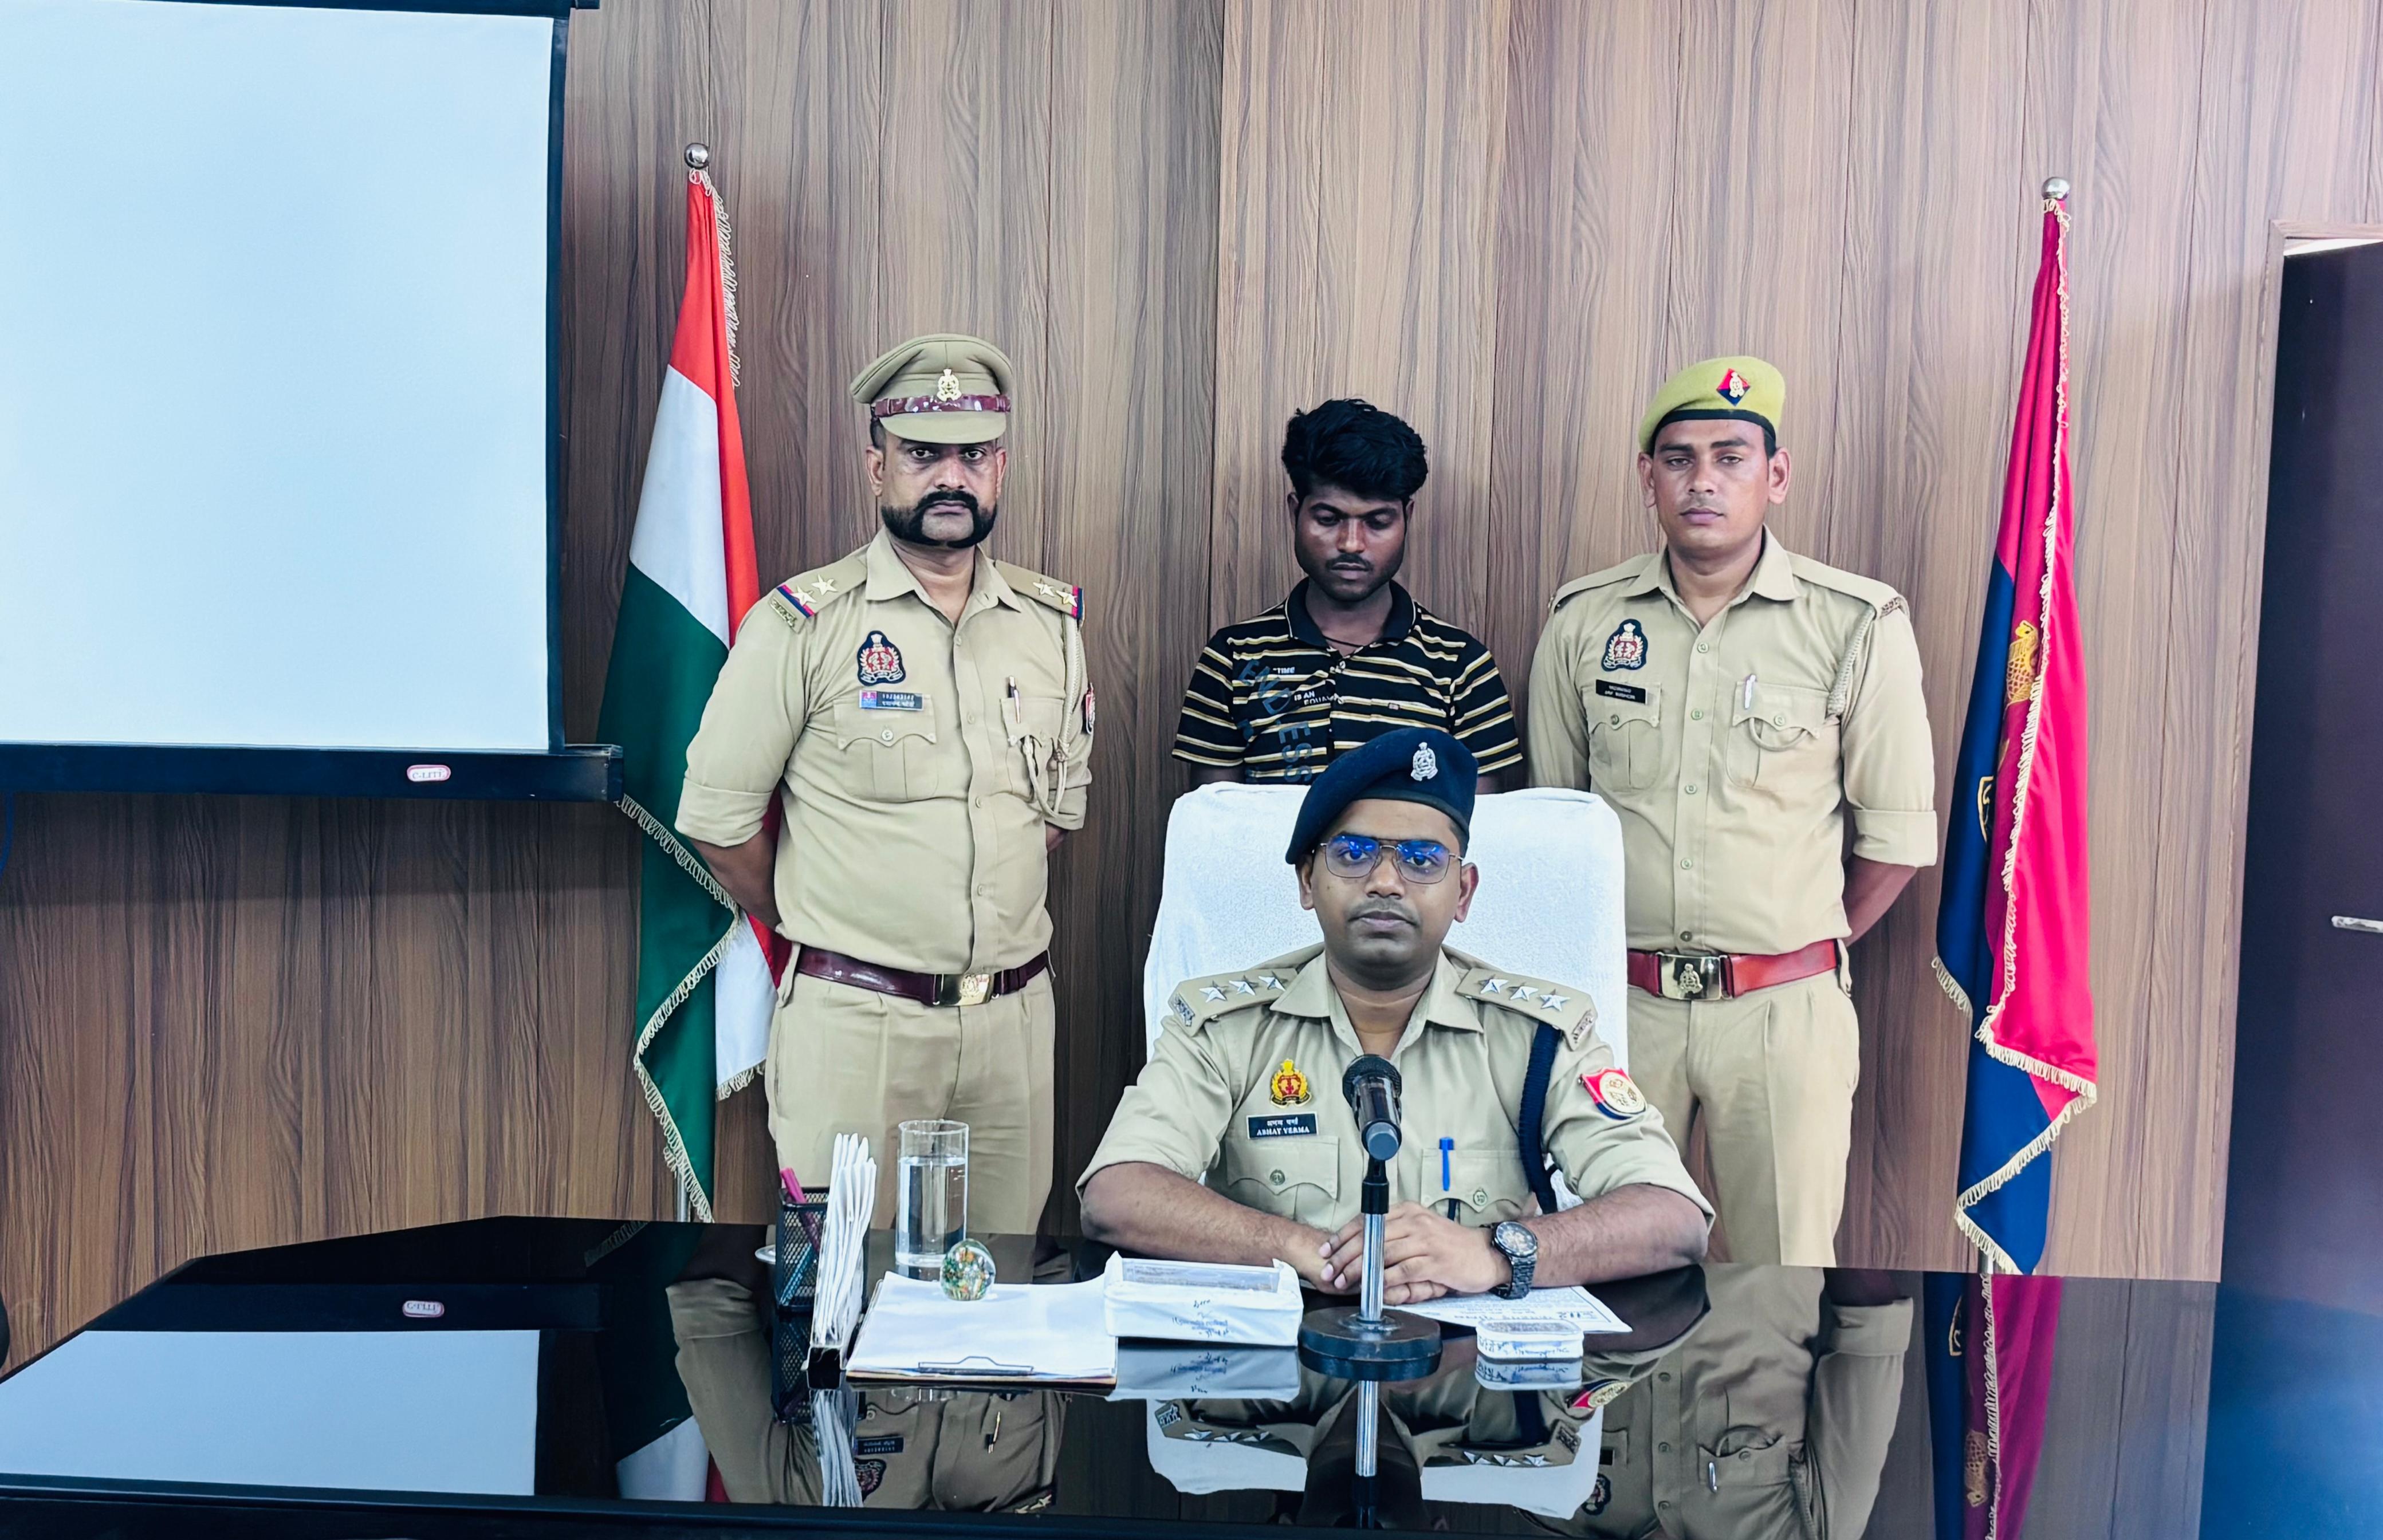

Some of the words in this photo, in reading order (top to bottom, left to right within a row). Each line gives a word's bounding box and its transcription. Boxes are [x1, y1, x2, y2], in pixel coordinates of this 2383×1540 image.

[1303, 691, 1315, 699] AN
[1257, 1128, 1282, 1136] ABHAY
[1283, 1126, 1310, 1135] VERMA
